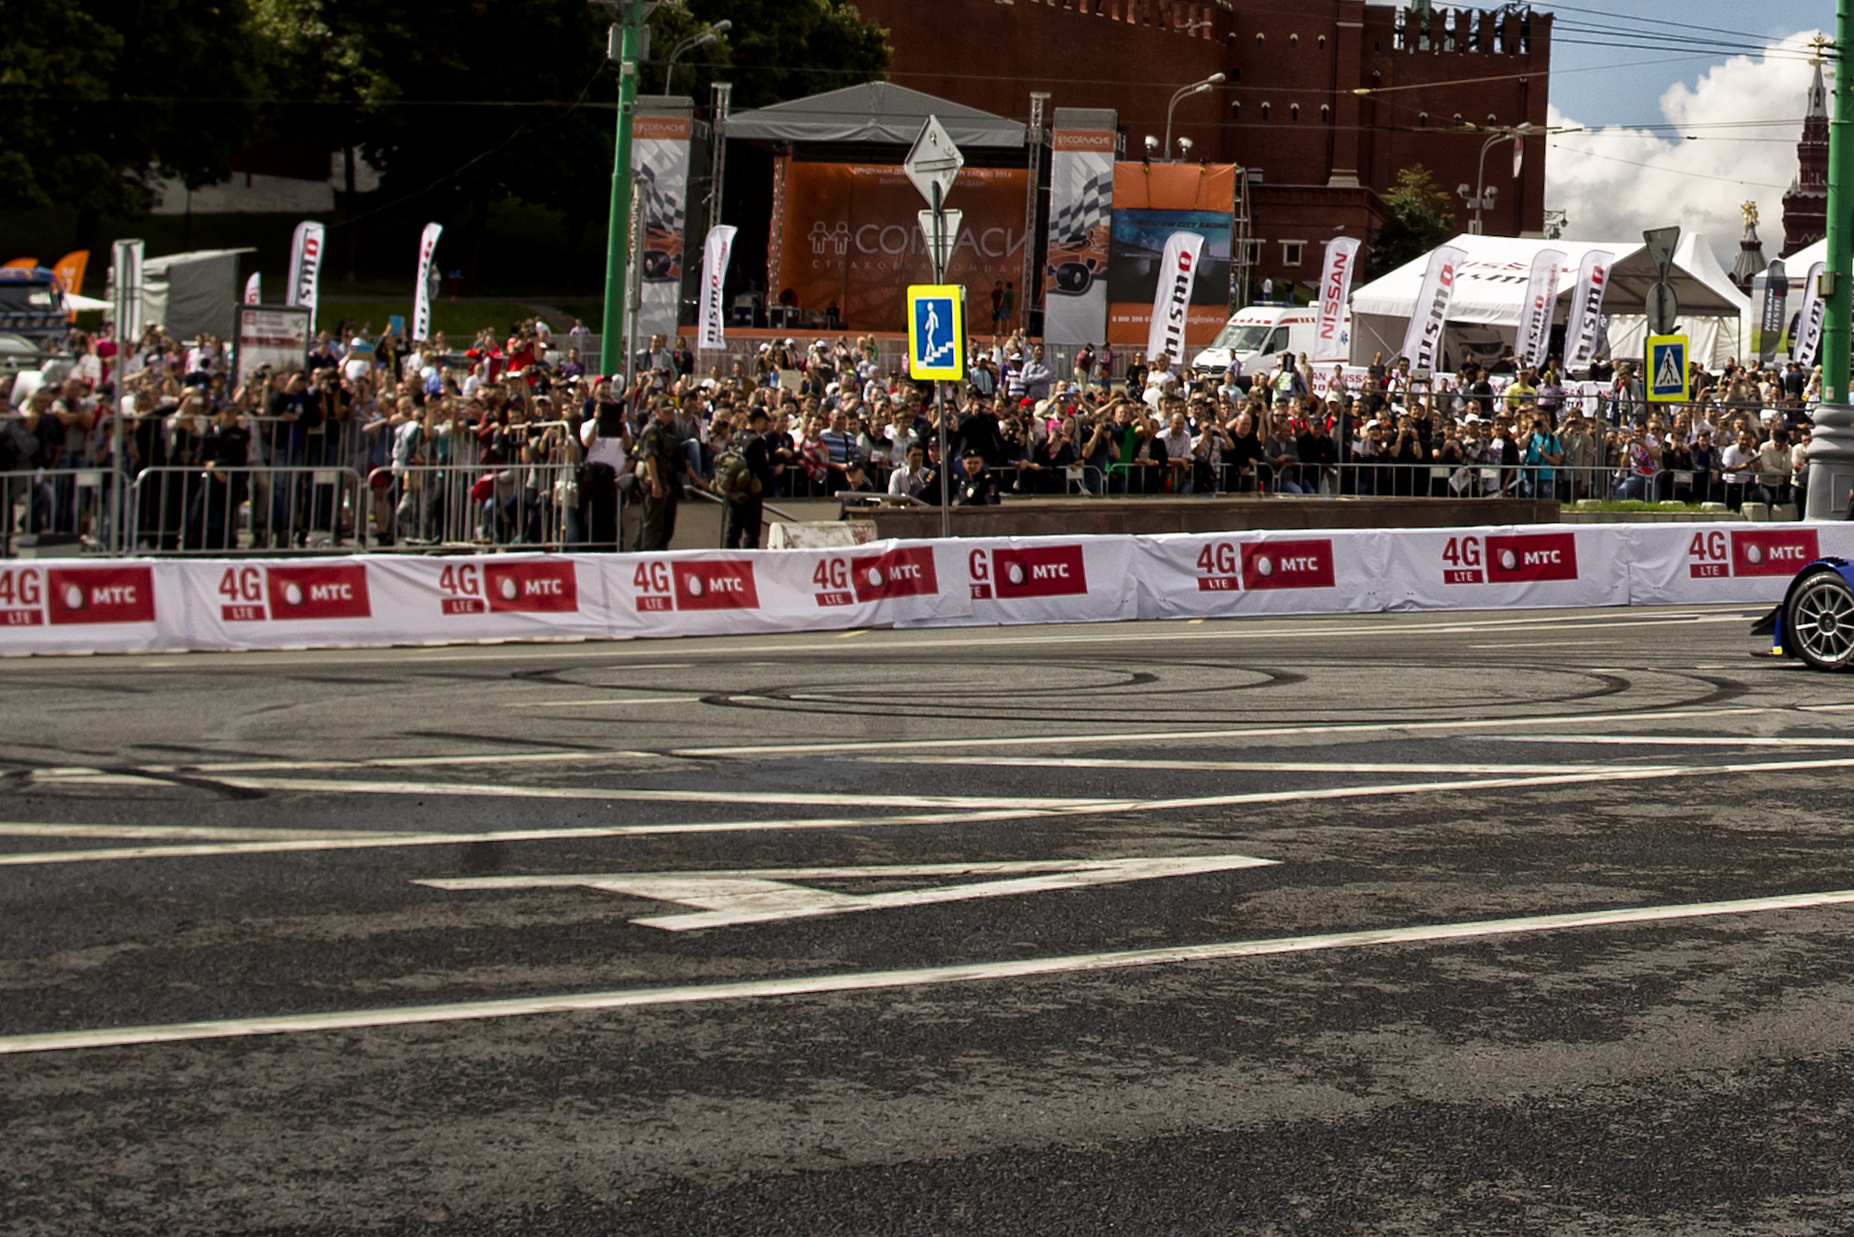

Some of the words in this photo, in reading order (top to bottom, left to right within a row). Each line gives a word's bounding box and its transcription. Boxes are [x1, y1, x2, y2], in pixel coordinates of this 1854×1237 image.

[708, 274, 718, 342] nismo
[1164, 251, 1192, 356] nismo
[1320, 252, 1347, 339] NISSAN
[1418, 264, 1455, 369] nismo
[1526, 295, 1544, 363] nismo
[1576, 265, 1605, 361] nismo
[1800, 300, 1823, 365] nism
[1196, 542, 1237, 574] 4G
[1442, 536, 1482, 568] 4G
[1688, 530, 1727, 561] 4G
[219, 566, 262, 602] 4G
[439, 563, 480, 596] 4G
[633, 560, 670, 593] 4G
[812, 557, 847, 590] 4G
[1208, 578, 1229, 590] LTE
[1453, 570, 1474, 583] LTE
[1700, 565, 1720, 577] LTE
[232, 606, 255, 620] LTE
[451, 599, 475, 613] LTE
[644, 598, 665, 610] LTE
[824, 593, 844, 606] LTE
[7, 611, 33, 625] LTE
